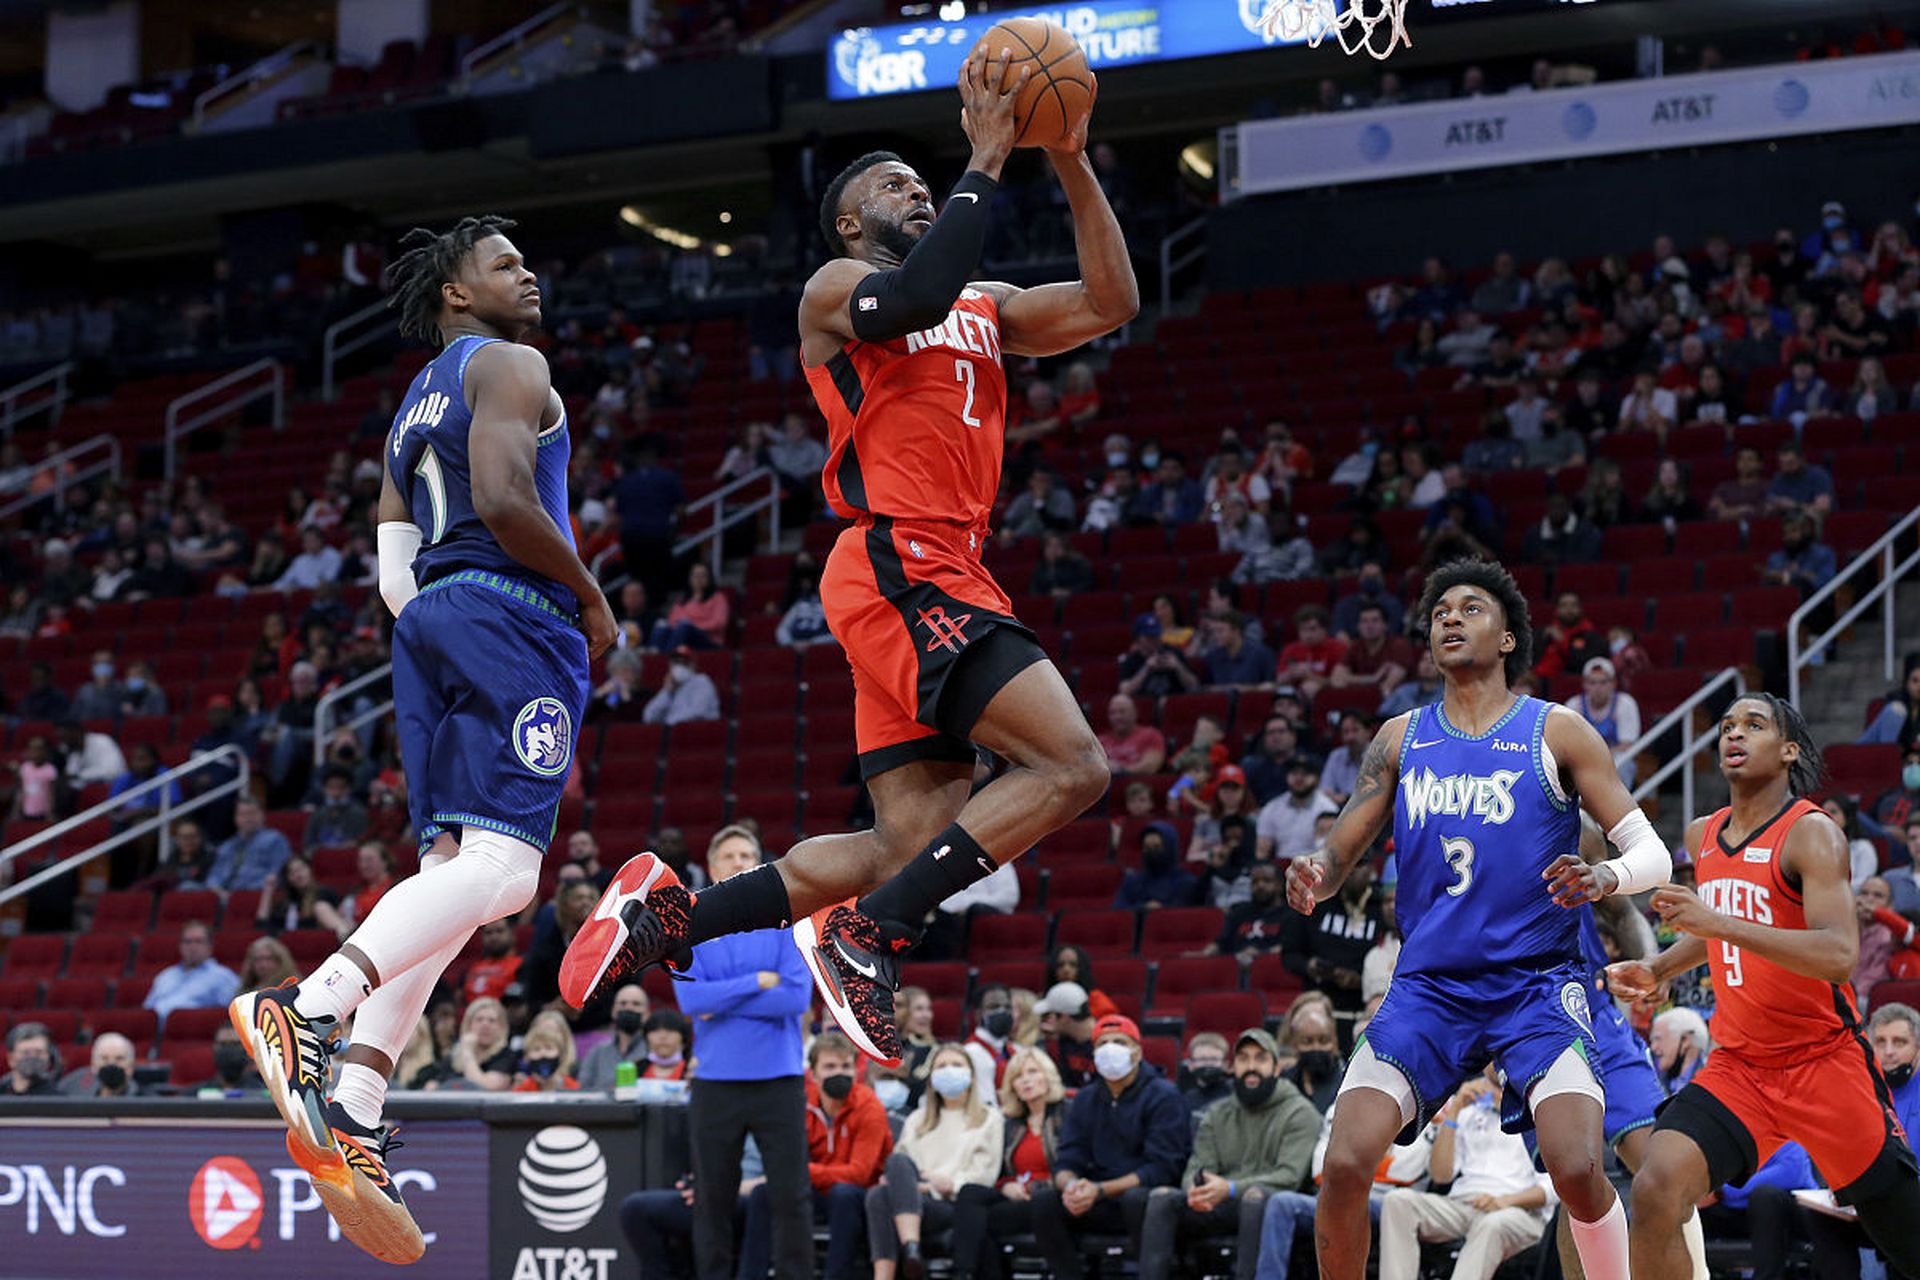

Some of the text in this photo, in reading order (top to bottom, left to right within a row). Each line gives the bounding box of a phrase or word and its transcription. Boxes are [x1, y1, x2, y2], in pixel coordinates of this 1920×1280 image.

[857, 50, 927, 95] KBR
[1445, 117, 1507, 145] AT&T
[1651, 95, 1717, 125] AT&T
[954, 359, 981, 427] 2
[415, 443, 447, 544] 1
[1400, 766, 1525, 830] WOLVES
[1440, 834, 1475, 896] 3
[1697, 877, 1773, 925] OCKETS
[1721, 940, 1744, 986] 9
[270, 1168, 437, 1244] PC
[511, 1247, 618, 1280] AT&T
